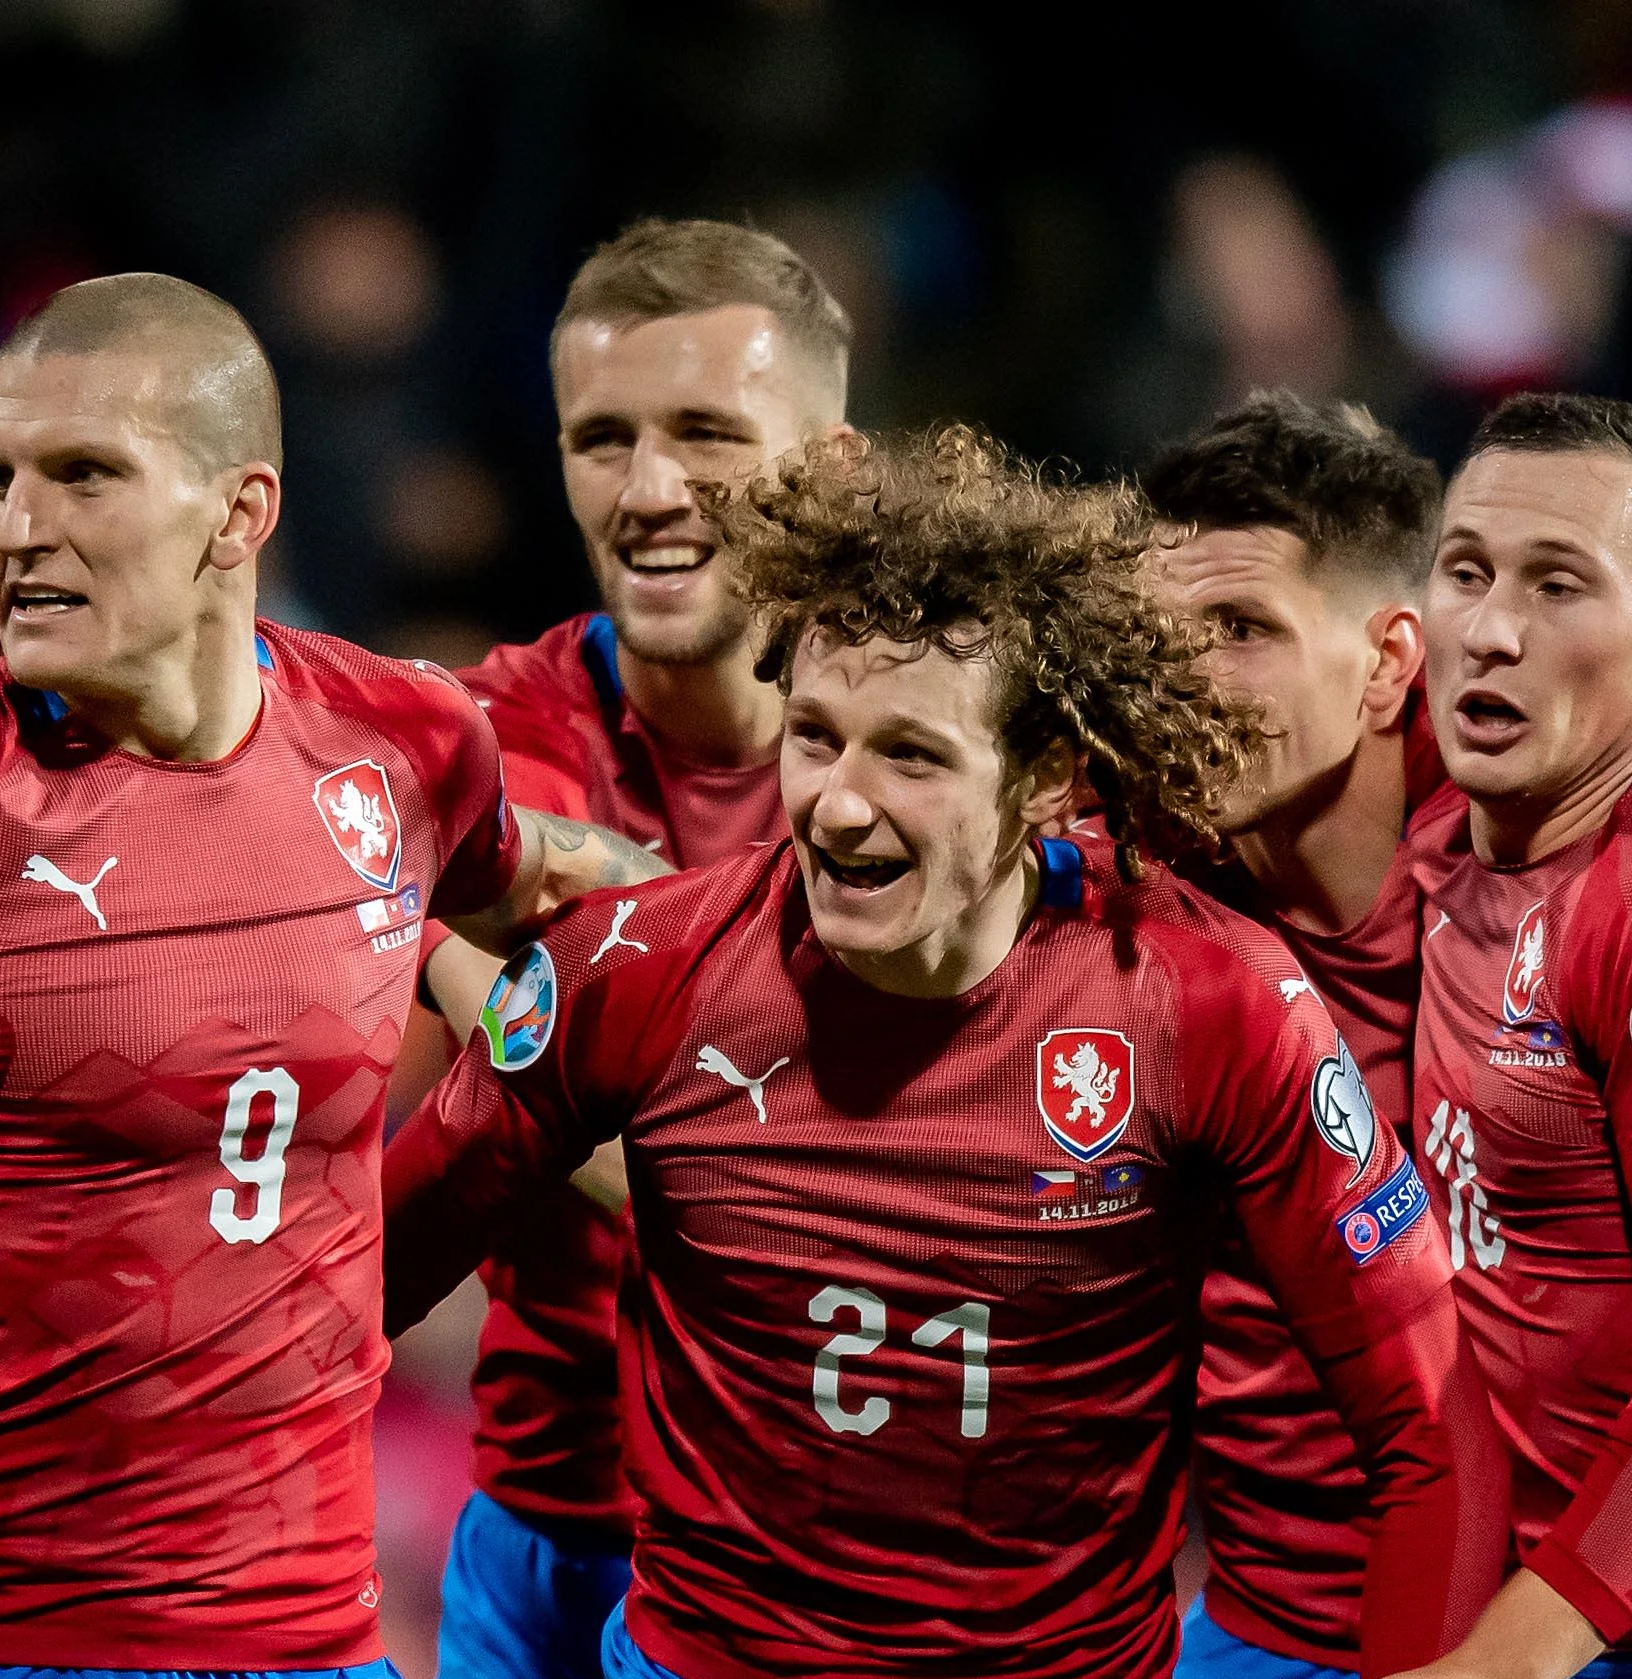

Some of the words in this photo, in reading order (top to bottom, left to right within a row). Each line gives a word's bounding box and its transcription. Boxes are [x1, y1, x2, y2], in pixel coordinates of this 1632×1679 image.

[210, 1067, 301, 1245] 9
[1376, 1172, 1425, 1229] RESPE
[808, 1285, 991, 1439] 21
